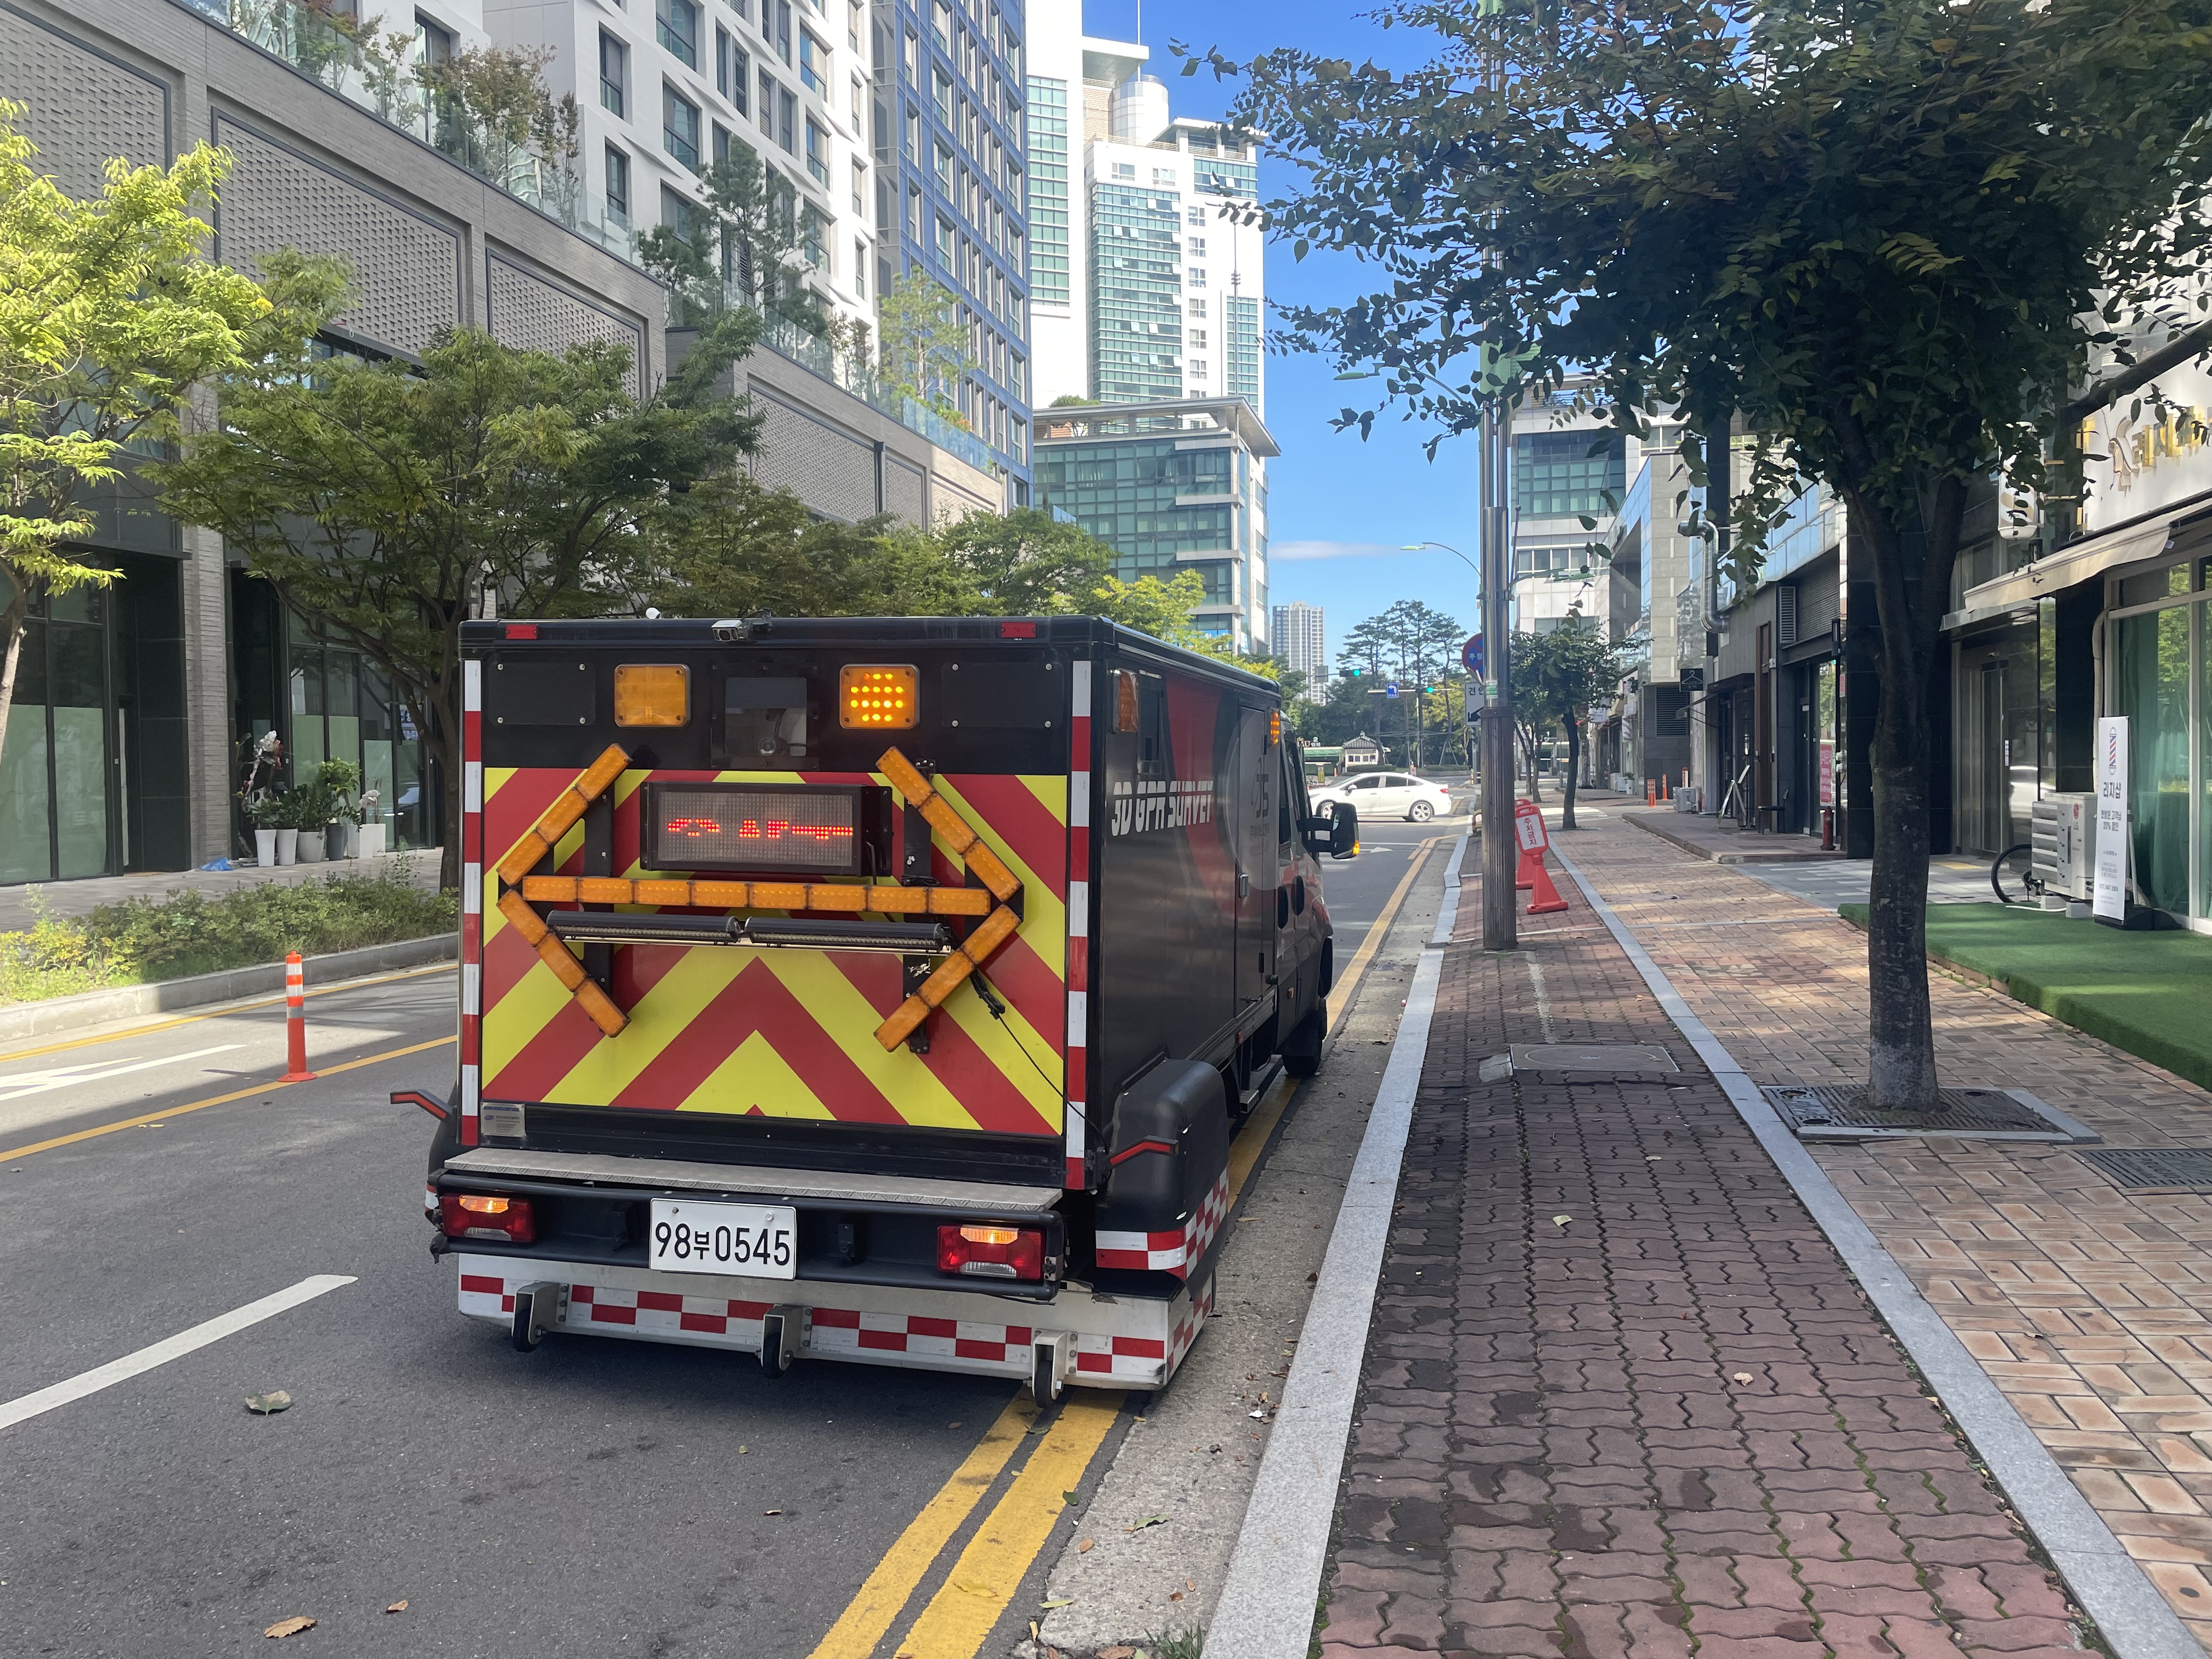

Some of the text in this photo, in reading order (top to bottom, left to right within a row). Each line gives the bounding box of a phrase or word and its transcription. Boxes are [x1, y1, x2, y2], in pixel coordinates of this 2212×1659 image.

[1111, 780, 1214, 836] 3D GPR SURVEY
[2103, 782, 2121, 799] 리지샵
[1524, 817, 1537, 845] 주차금지
[655, 1222, 790, 1266] 98부0545
